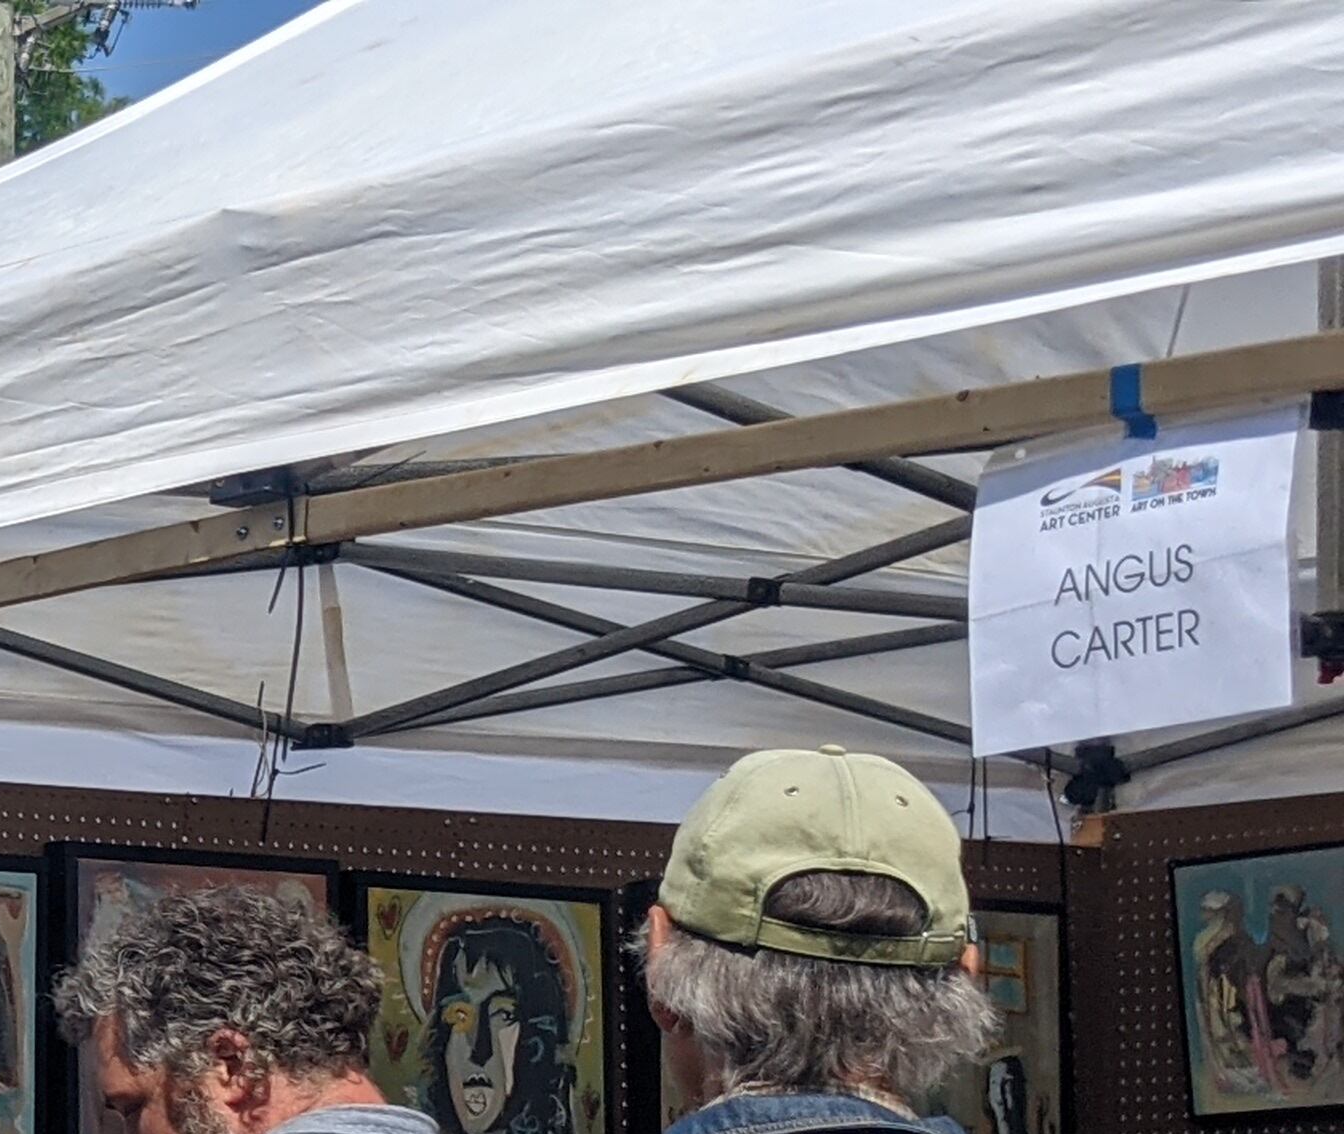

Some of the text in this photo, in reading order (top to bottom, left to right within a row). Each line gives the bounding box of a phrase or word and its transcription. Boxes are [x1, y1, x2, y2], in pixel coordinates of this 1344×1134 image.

[1040, 504, 1121, 532] ART CENTER
[1130, 487, 1216, 513] ART ON THE TOWN
[1054, 544, 1194, 606] ANGUS
[1051, 609, 1200, 669] CARTER
